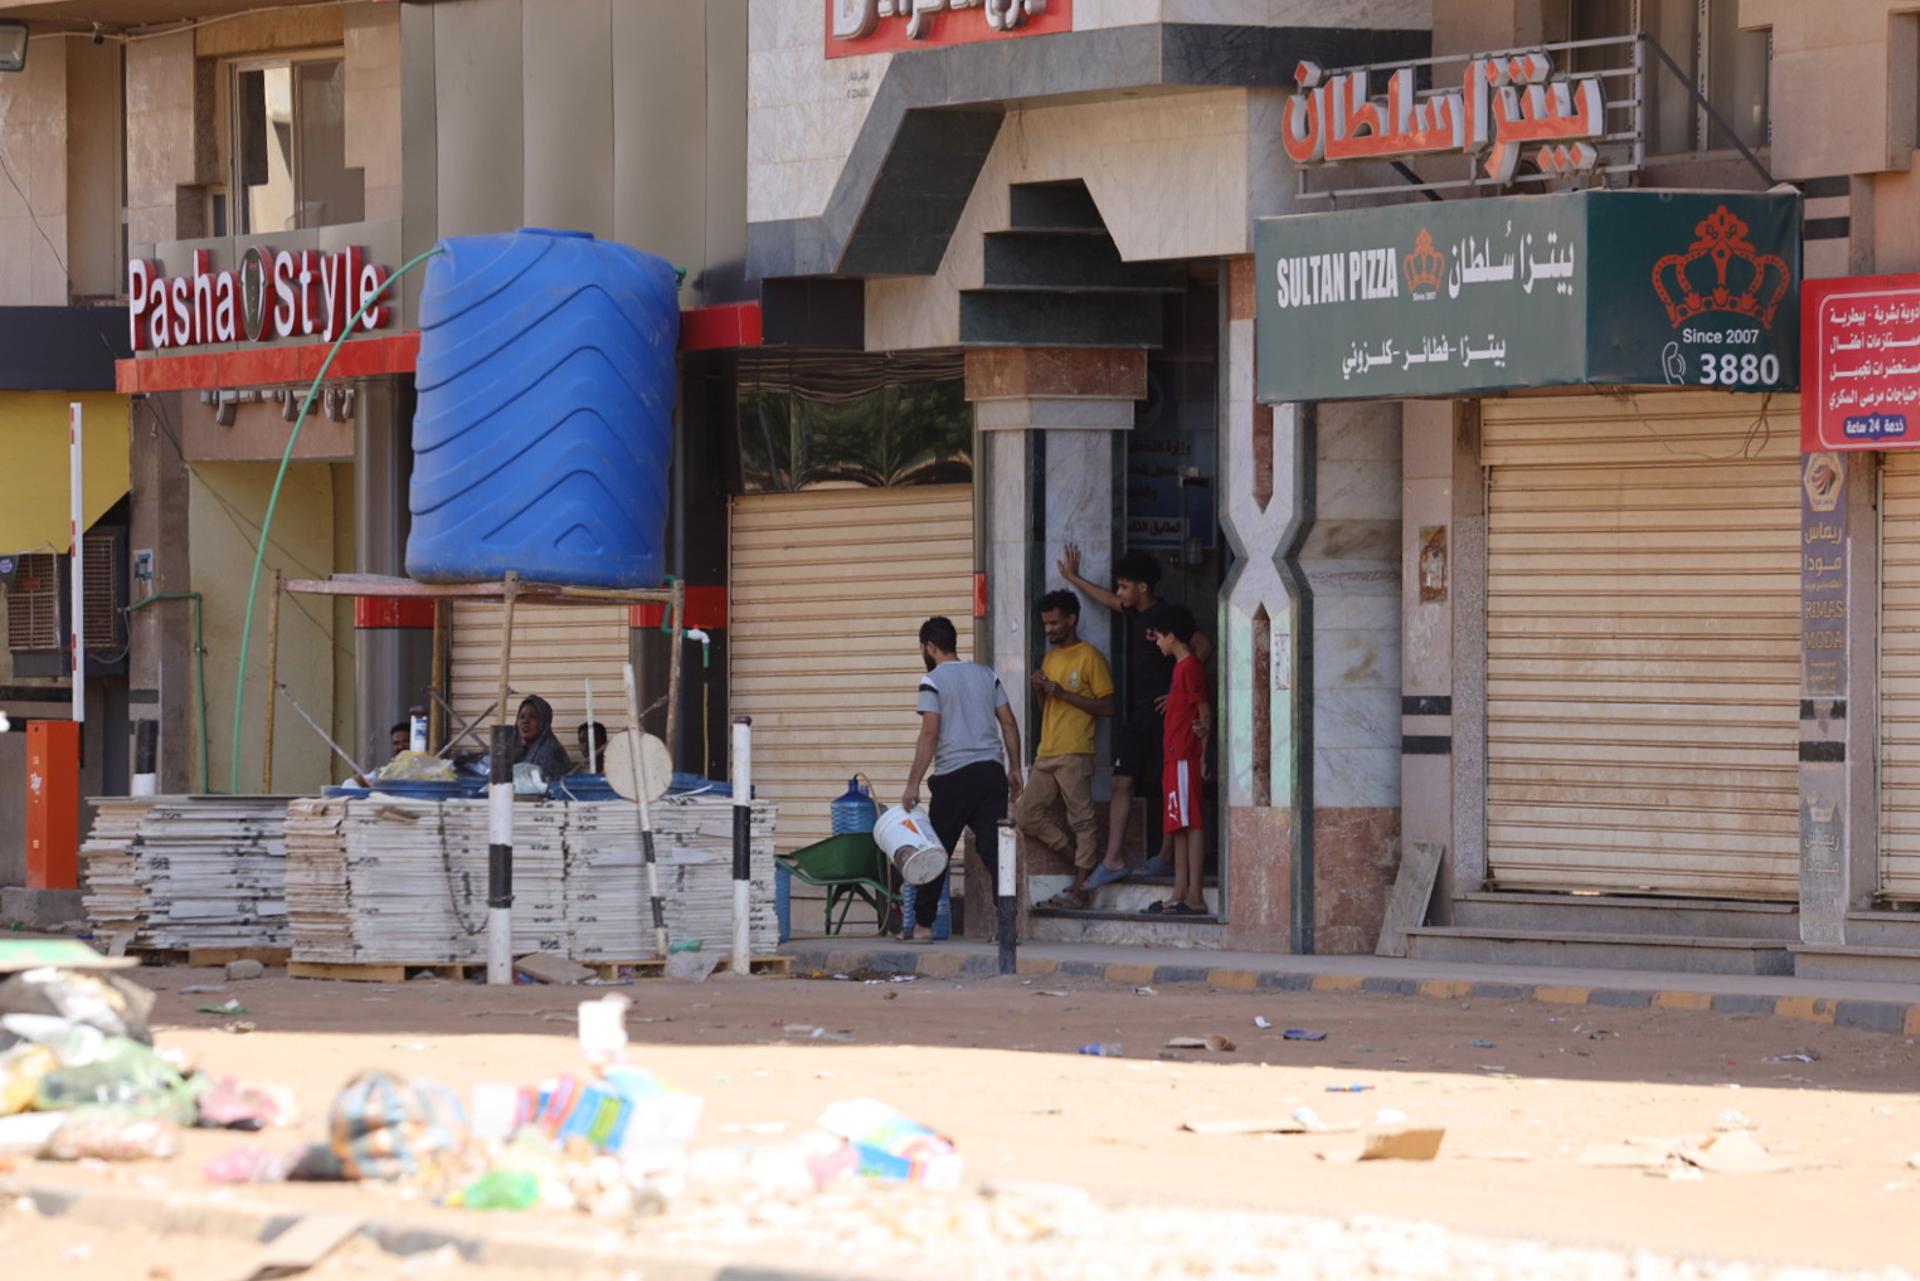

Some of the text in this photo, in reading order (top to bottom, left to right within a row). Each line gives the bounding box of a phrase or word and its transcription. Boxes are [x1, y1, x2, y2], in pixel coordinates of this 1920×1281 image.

[1282, 51, 1602, 186] بيتزا سلطان
[1519, 231, 1575, 296] بيتزا
[1277, 247, 1399, 309] SULTAN PIZZA
[129, 245, 382, 350] Pasha Style
[1682, 328, 1760, 344] Since 2007
[1460, 333, 1506, 368] بيتزا
[1700, 353, 1779, 385] 3880
[1868, 418, 1880, 432] 24
[1804, 522, 1842, 545] ريماس
[1804, 554, 1842, 577] مودا
[1803, 601, 1845, 618] RIMAS
[1803, 631, 1844, 649] MODA
